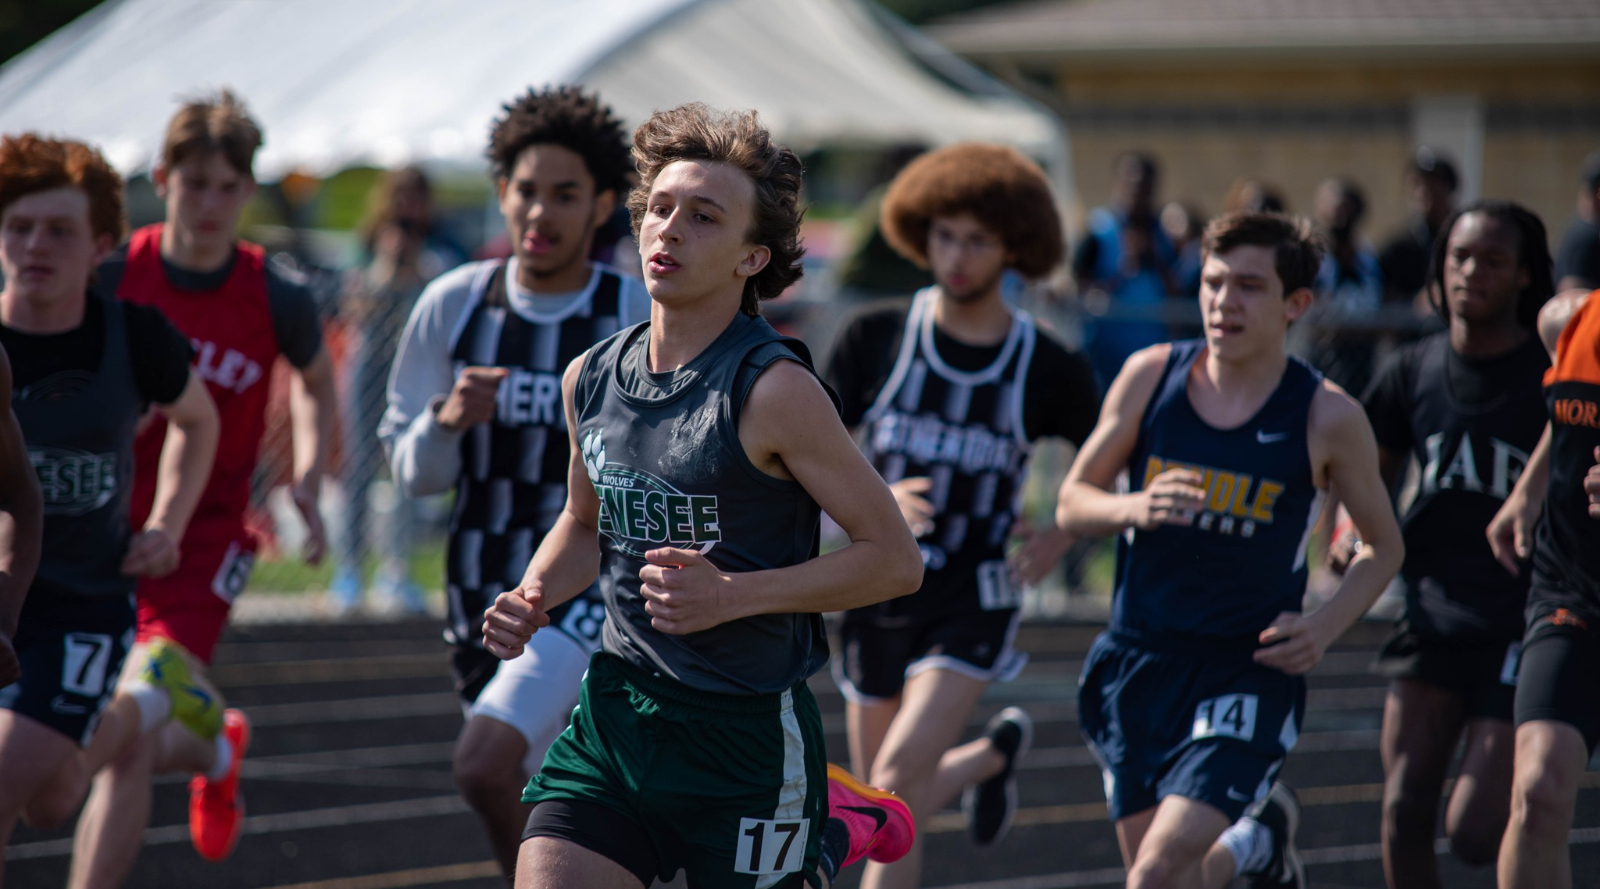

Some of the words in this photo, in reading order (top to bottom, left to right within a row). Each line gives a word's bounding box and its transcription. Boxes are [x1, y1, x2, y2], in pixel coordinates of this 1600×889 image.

[602, 475, 634, 488] WOLVES
[71, 635, 104, 687] 7
[1202, 698, 1246, 733] 14
[744, 821, 801, 872] 17
